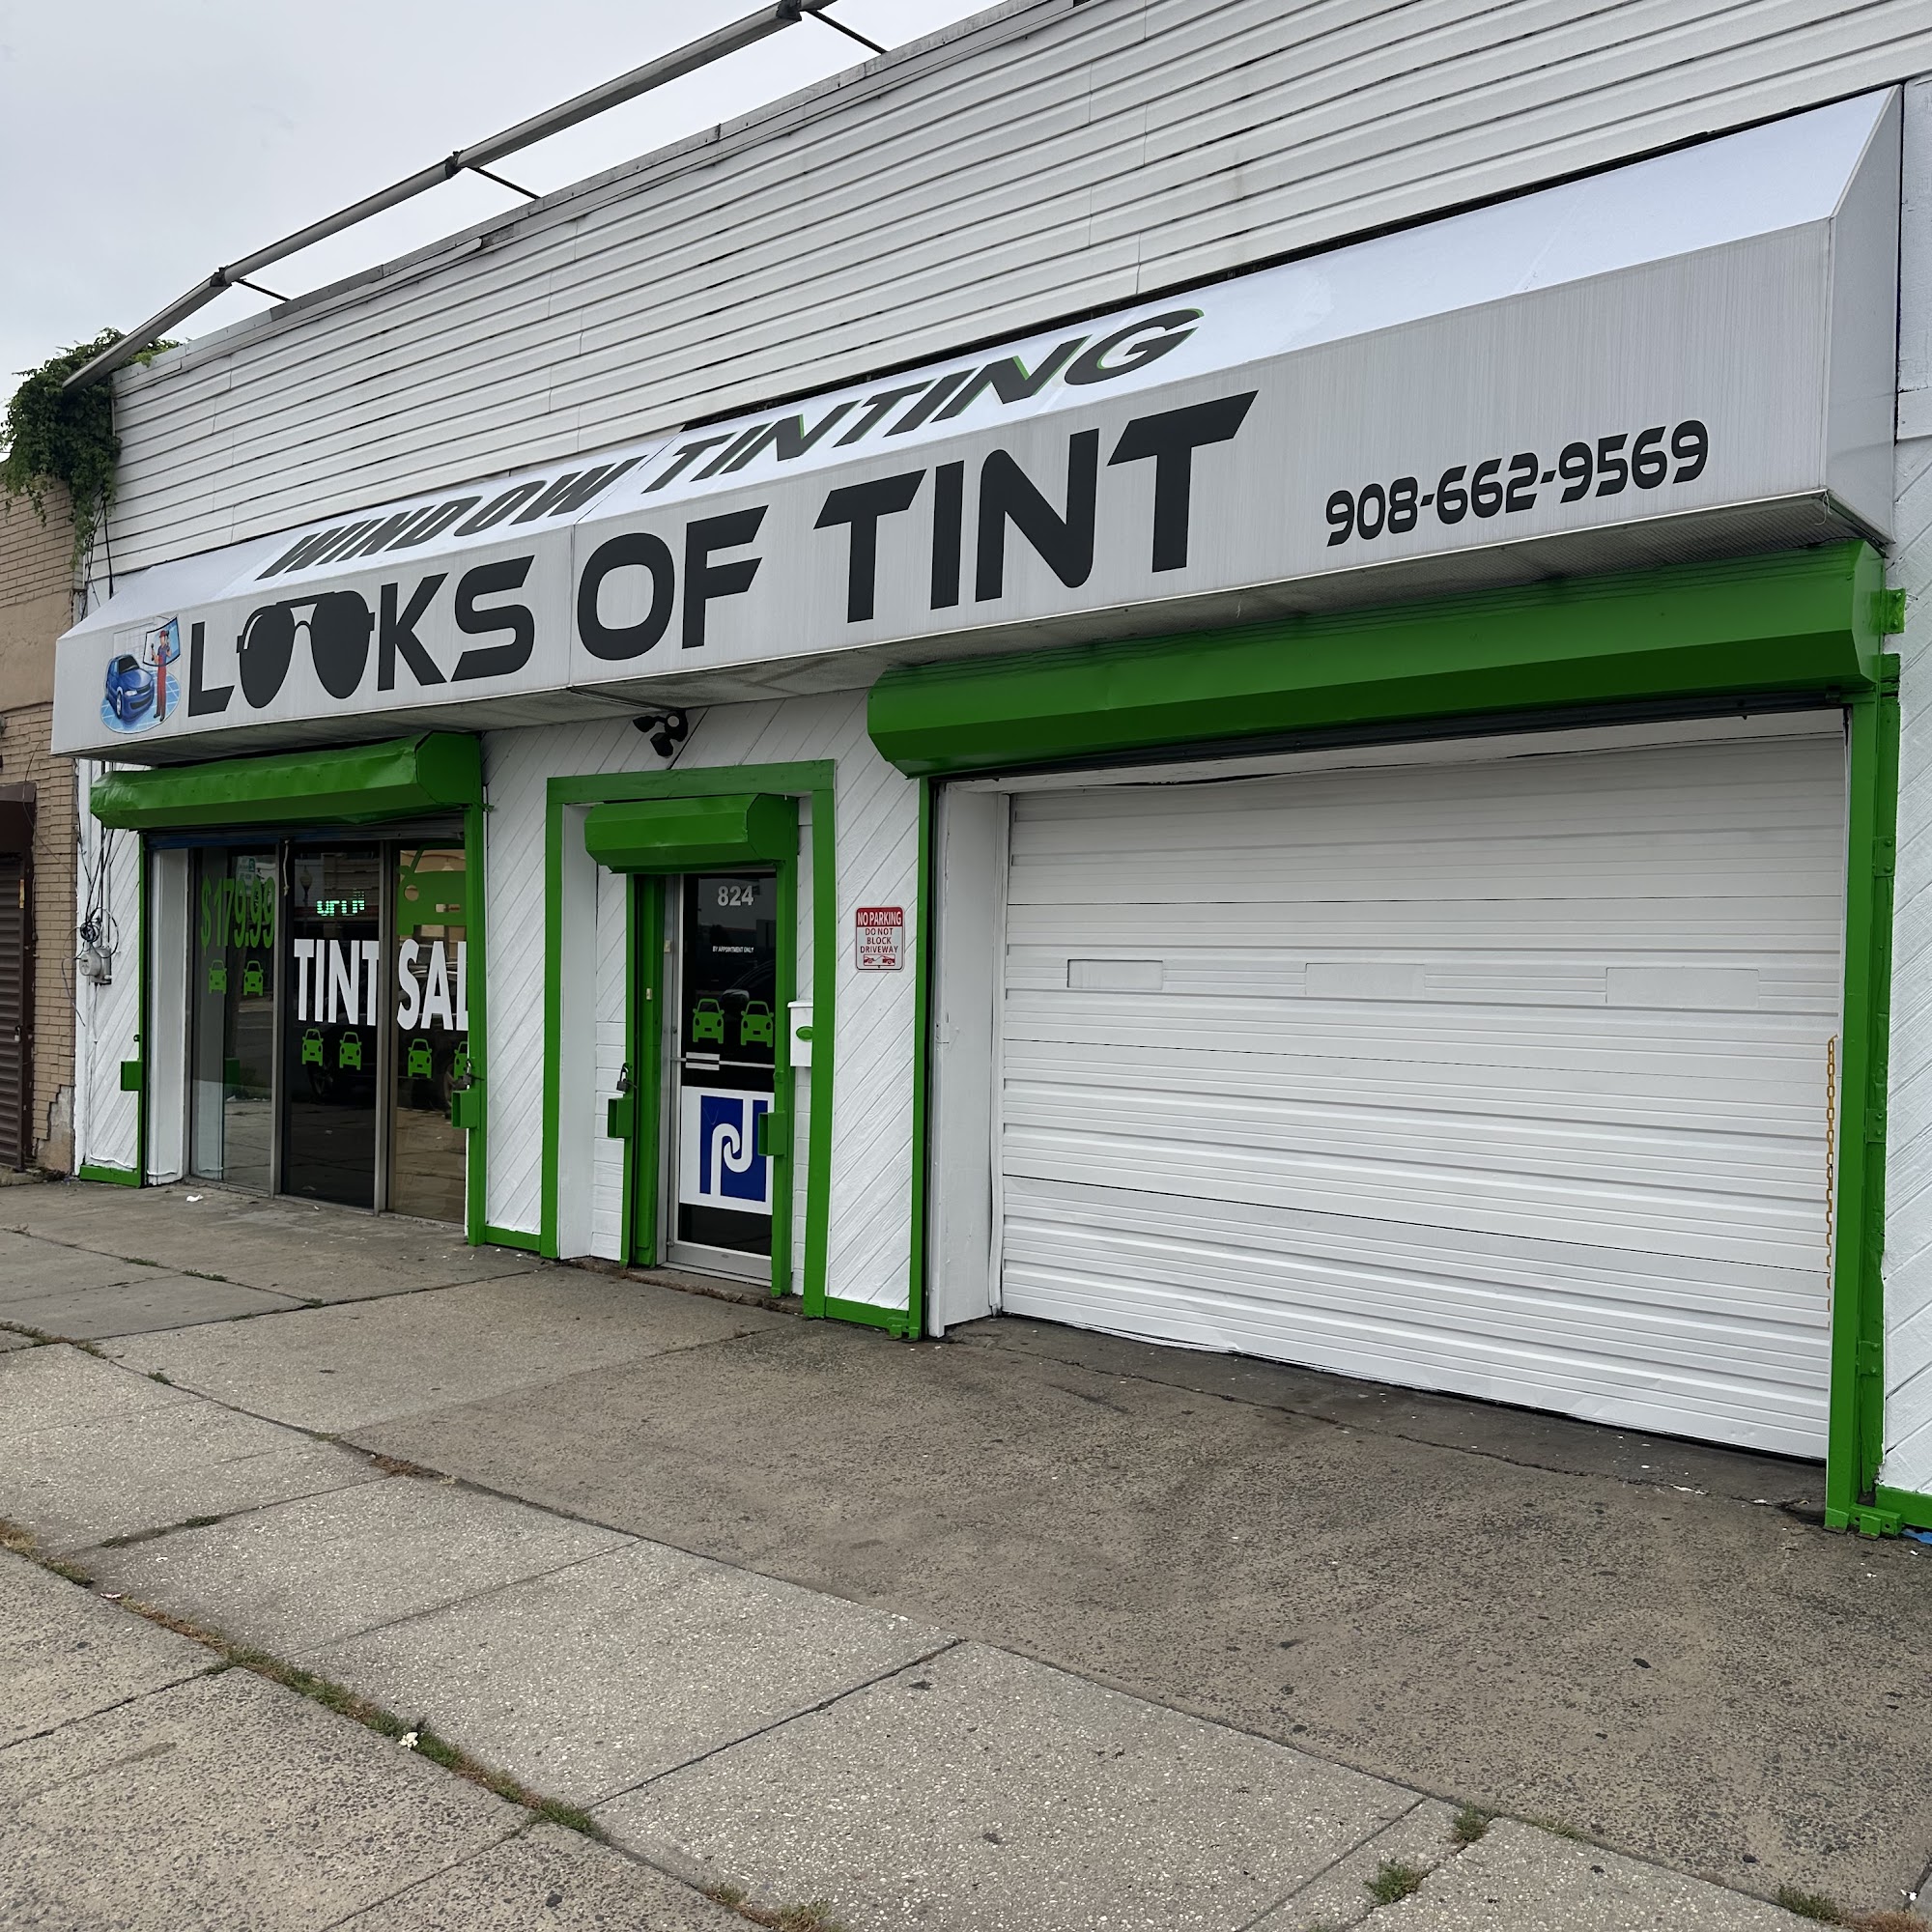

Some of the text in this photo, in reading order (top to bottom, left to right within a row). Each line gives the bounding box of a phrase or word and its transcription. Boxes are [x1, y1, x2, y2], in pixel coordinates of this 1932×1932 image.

[256, 308, 1205, 580] WINDOW TINTING
[1325, 419, 1709, 548] 908-662-9569
[578, 504, 769, 661] OF
[813, 389, 1259, 623] TINT
[200, 873, 276, 956] $179.99
[717, 885, 754, 907] 824
[857, 911, 902, 925] NO PARKING
[860, 945, 899, 953] DRIVEWAY
[865, 927, 894, 936] DO NOT
[867, 936, 892, 945] BLOCK
[294, 938, 379, 1027] TINT
